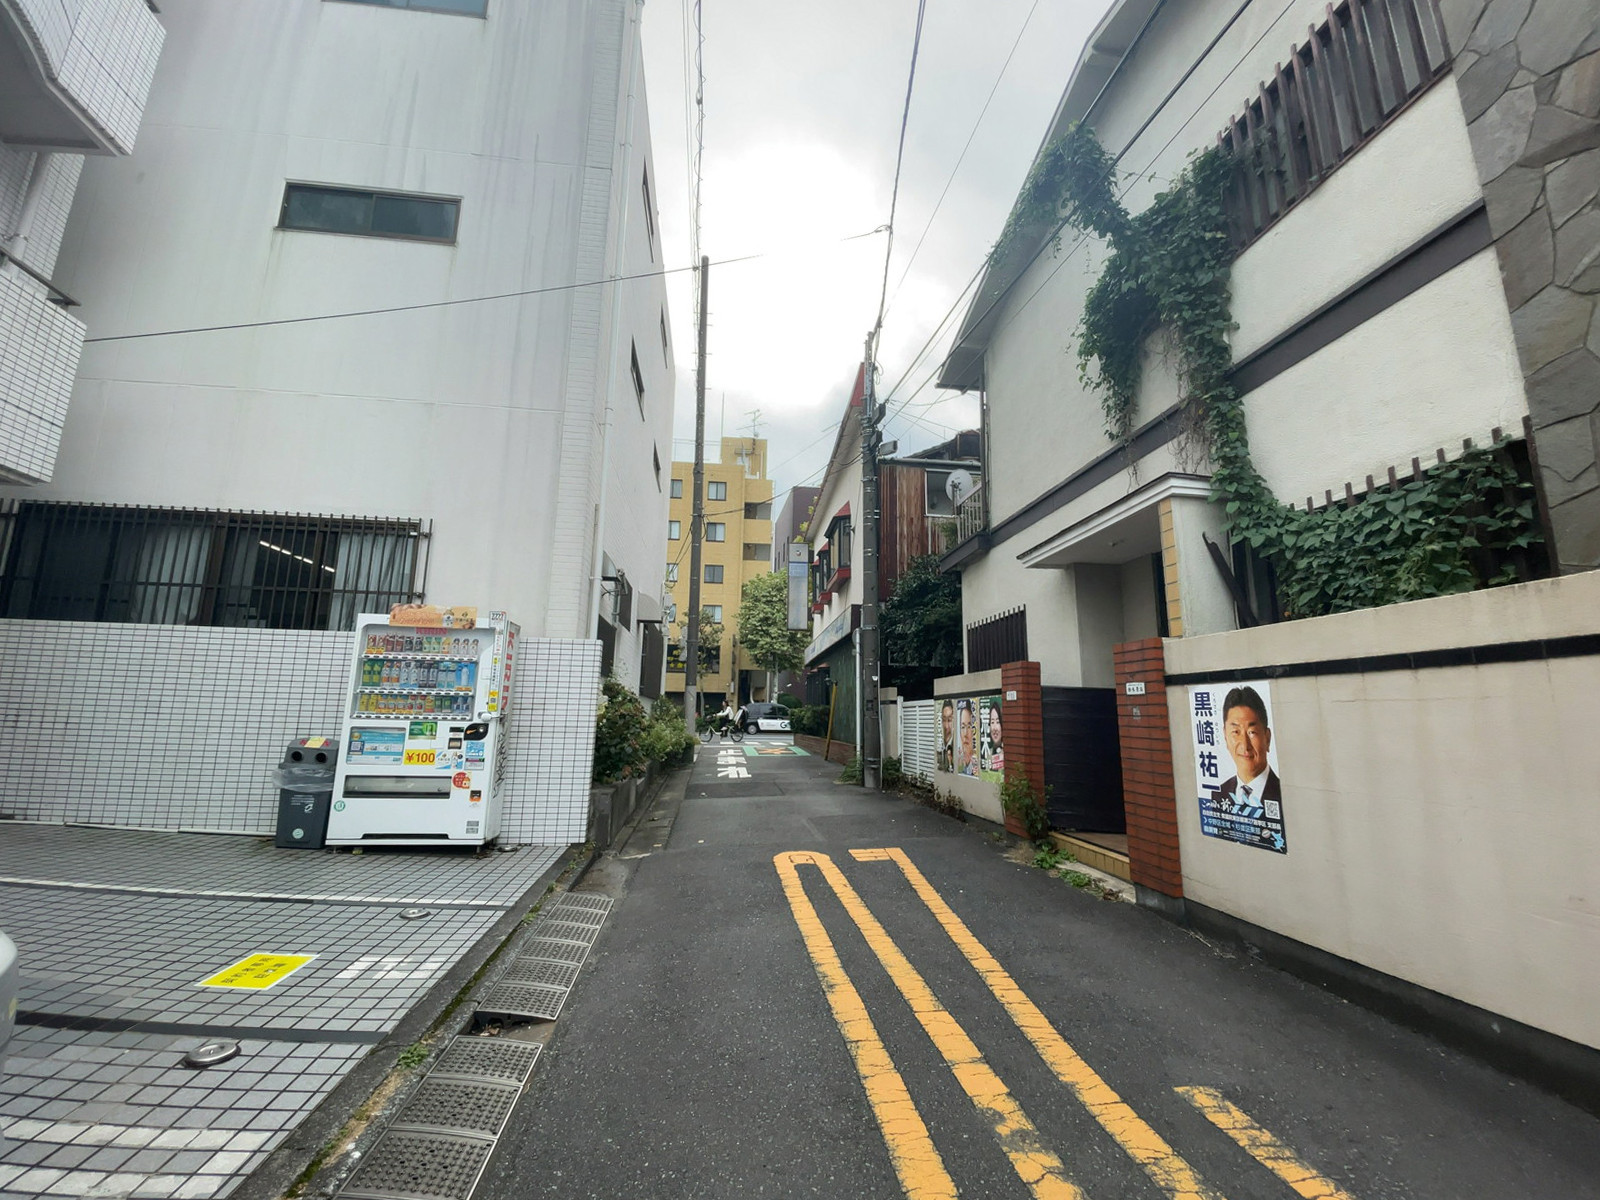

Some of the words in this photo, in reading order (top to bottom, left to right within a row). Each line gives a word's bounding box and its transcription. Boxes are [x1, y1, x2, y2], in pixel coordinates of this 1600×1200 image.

[501, 631, 515, 711] KIRIN
[406, 752, 436, 763] ¥100
[1194, 691, 1221, 792] 黒崎祐一
